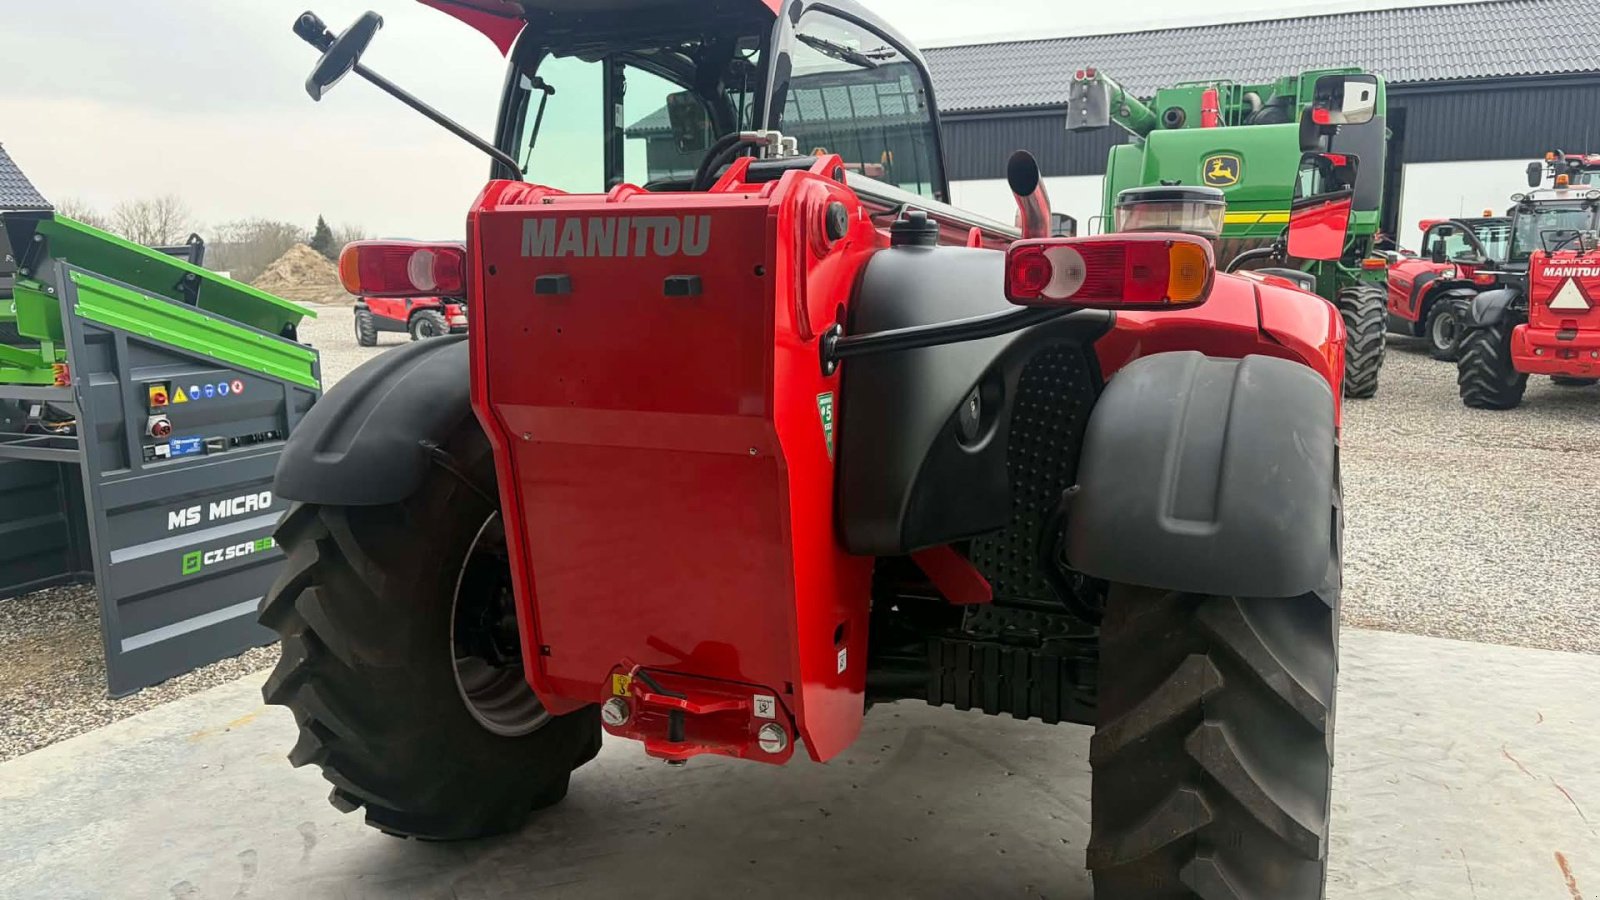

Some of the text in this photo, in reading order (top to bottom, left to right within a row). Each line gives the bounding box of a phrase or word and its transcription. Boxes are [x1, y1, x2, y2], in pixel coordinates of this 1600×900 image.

[521, 215, 711, 257] MANITOU
[1543, 266, 1600, 277] MANITOU
[168, 491, 272, 530] MS MICRO
